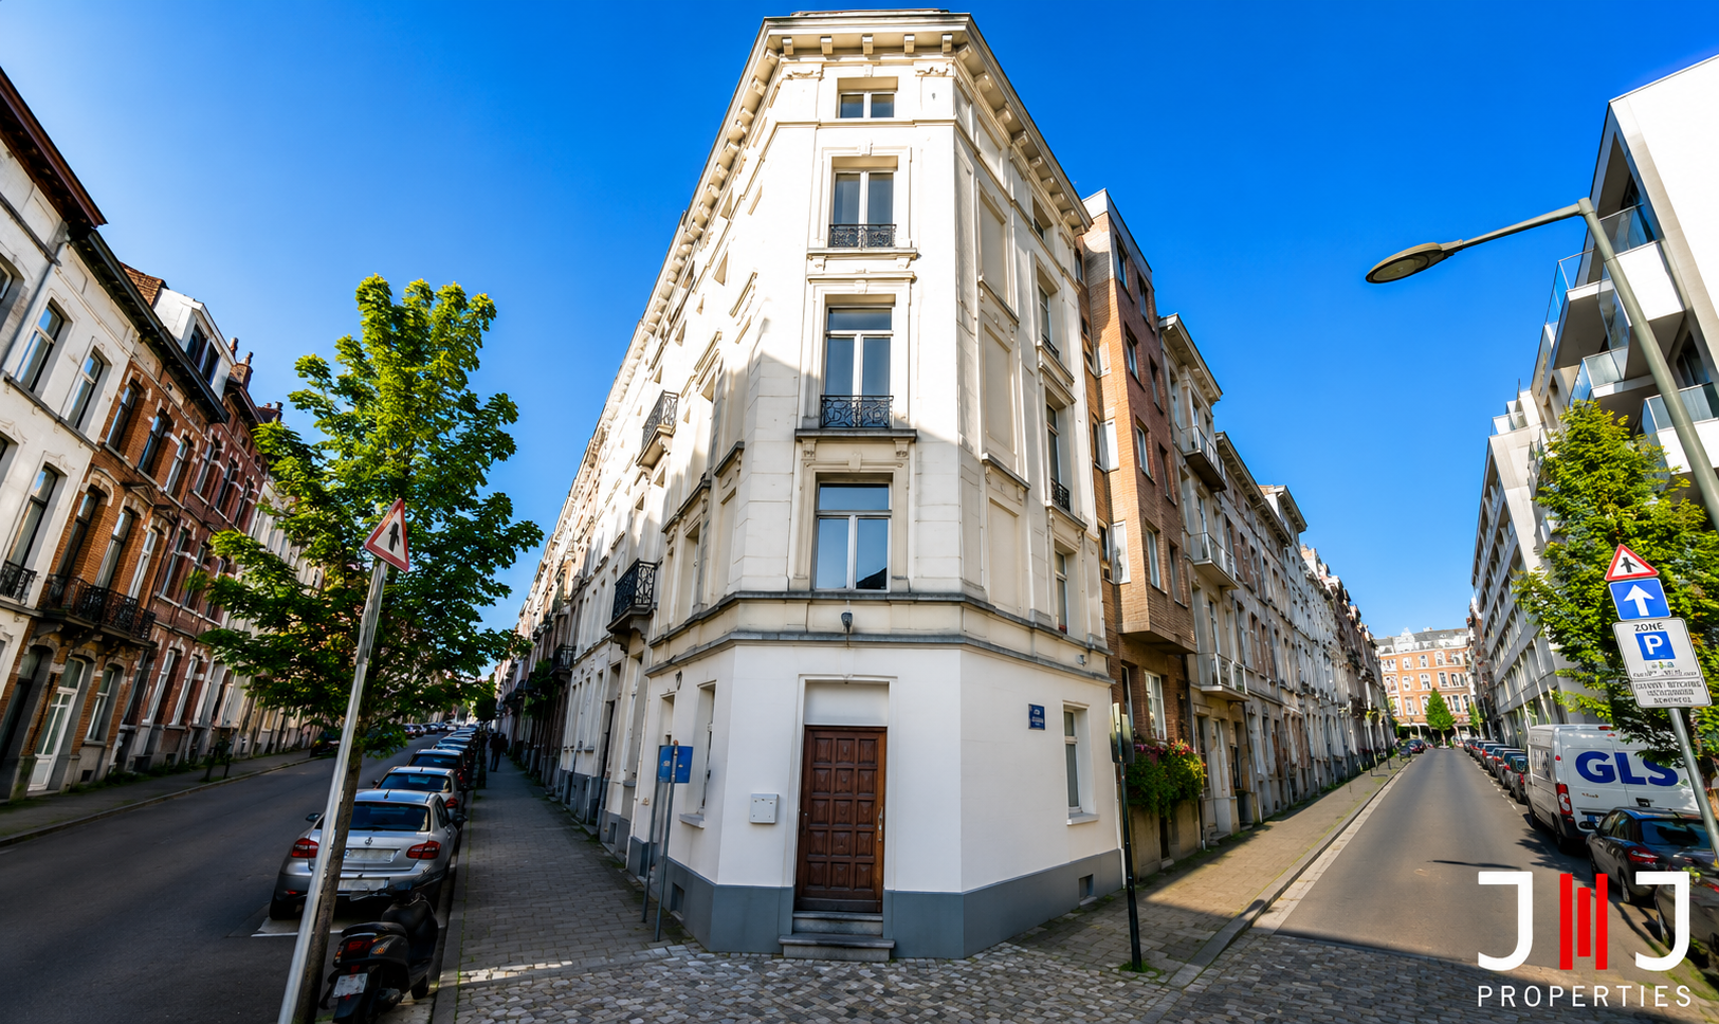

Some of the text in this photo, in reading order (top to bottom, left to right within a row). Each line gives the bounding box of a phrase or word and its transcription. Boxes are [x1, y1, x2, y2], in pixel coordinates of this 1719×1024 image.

[1634, 622, 1664, 632] ZONE
[1643, 635, 1663, 655] P
[1575, 750, 1679, 787] GLS
